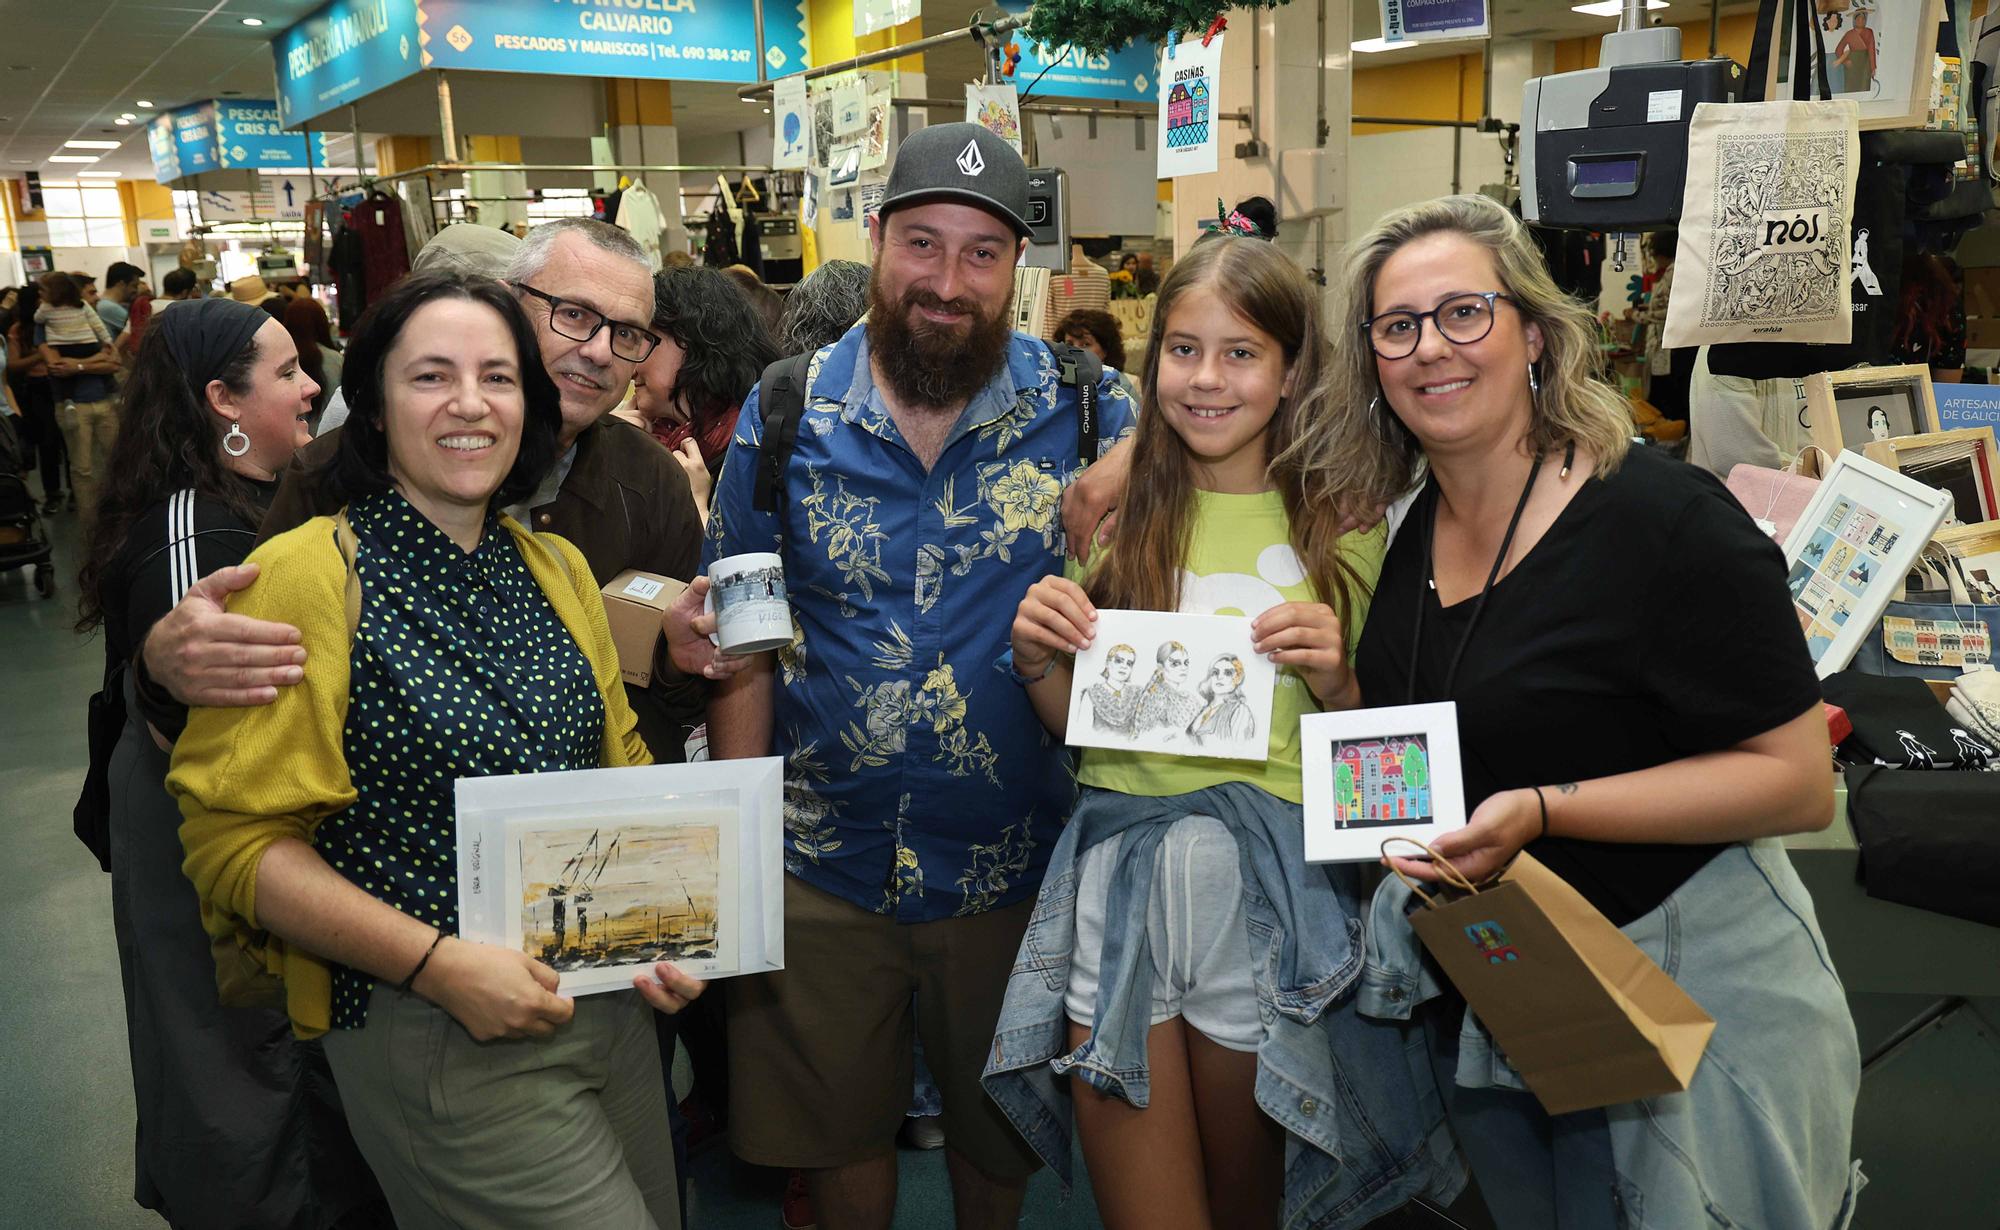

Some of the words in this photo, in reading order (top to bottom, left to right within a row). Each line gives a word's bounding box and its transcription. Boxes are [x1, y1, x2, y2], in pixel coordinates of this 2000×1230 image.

[579, 11, 673, 35] CALVARIO
[452, 34, 467, 44] 56
[494, 34, 567, 52] PESCADOS
[568, 39, 579, 53] Y
[581, 40, 648, 57] MARISCOS
[656, 44, 680, 59] Tel.
[682, 46, 705, 60] 690
[706, 47, 729, 62] 384
[730, 49, 751, 63] 247
[1037, 42, 1111, 71] NIEVES
[1174, 66, 1205, 82] CASIÑAS
[234, 122, 266, 135] CRIS
[1763, 213, 1826, 246] nós.
[1081, 385, 1090, 434] Quechua
[1943, 410, 1959, 420] DE
